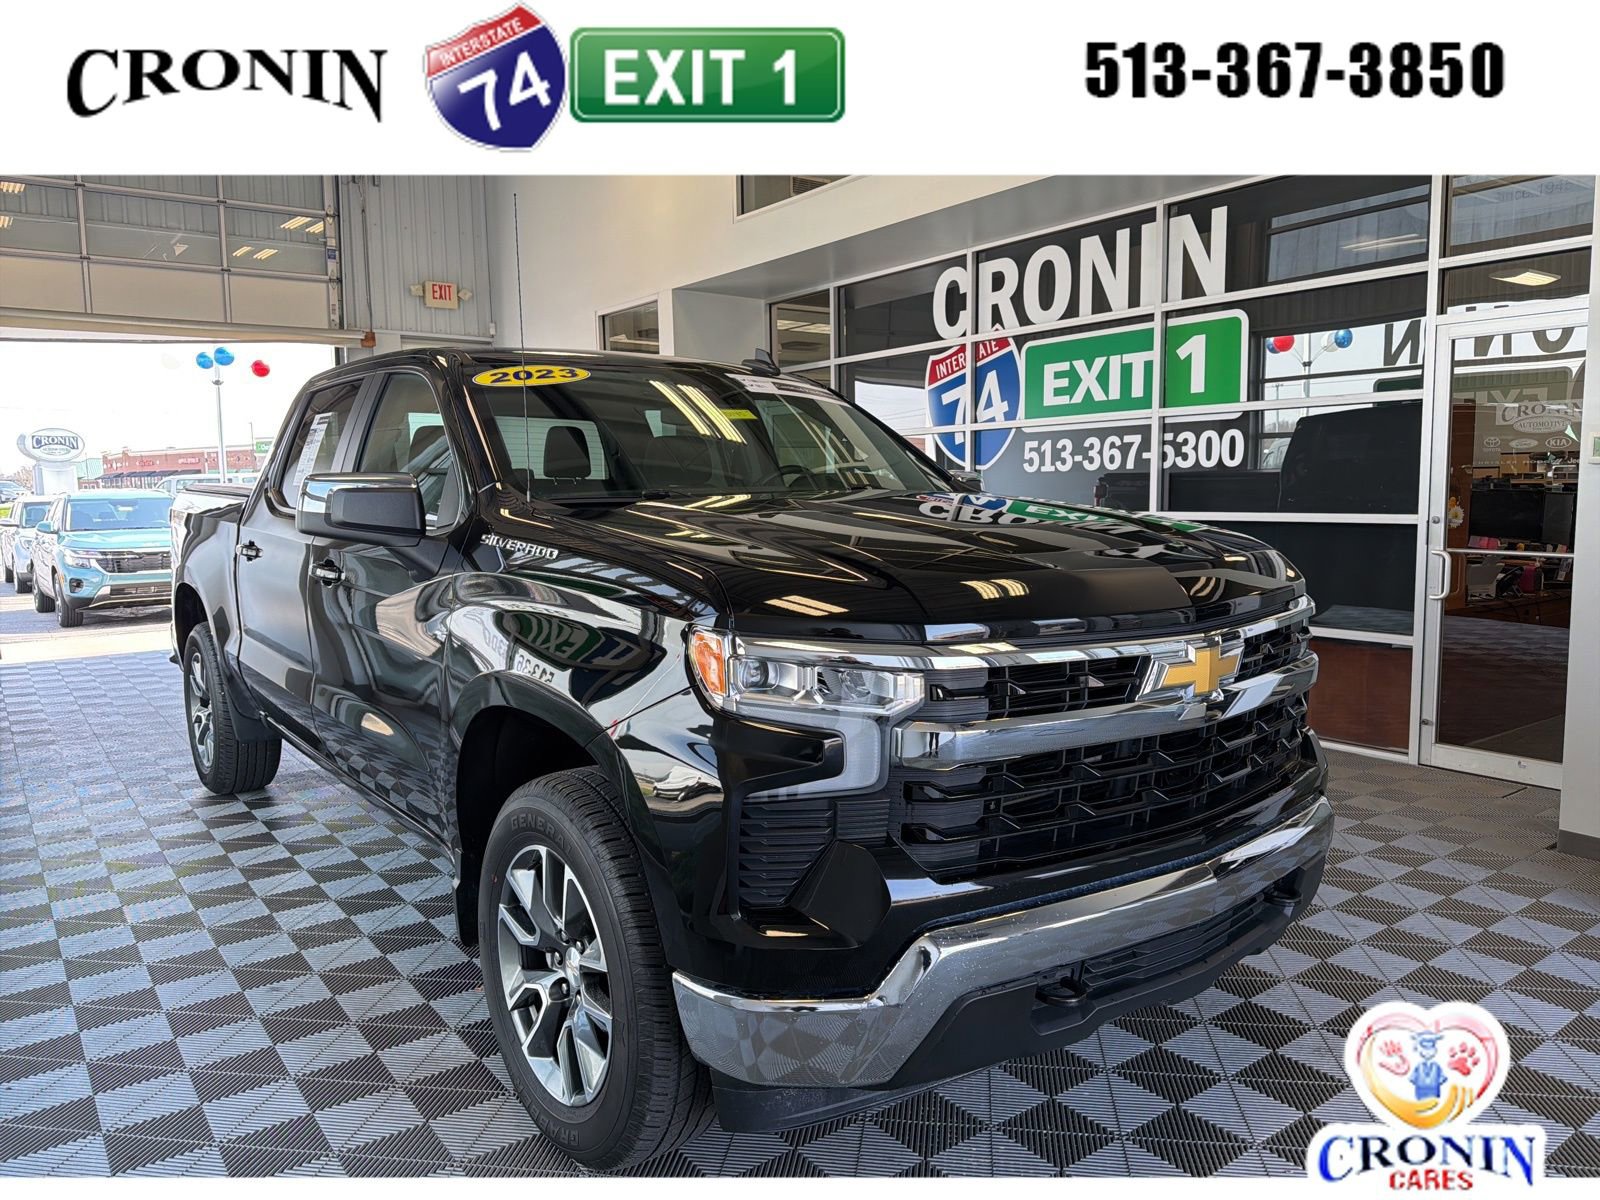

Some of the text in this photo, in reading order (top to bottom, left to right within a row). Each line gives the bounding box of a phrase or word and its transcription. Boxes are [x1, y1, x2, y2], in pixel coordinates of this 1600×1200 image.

[431, 283, 453, 301] EXIT
[932, 205, 1228, 340] CRONIN
[489, 368, 578, 384] 2023
[935, 339, 999, 379] INTERATE
[1042, 333, 1206, 407] EXIT 1
[940, 369, 1009, 446] 74
[33, 435, 78, 449] CRONIN
[1022, 428, 1245, 473] 513-367-5300
[480, 533, 559, 560] SILVERADO
